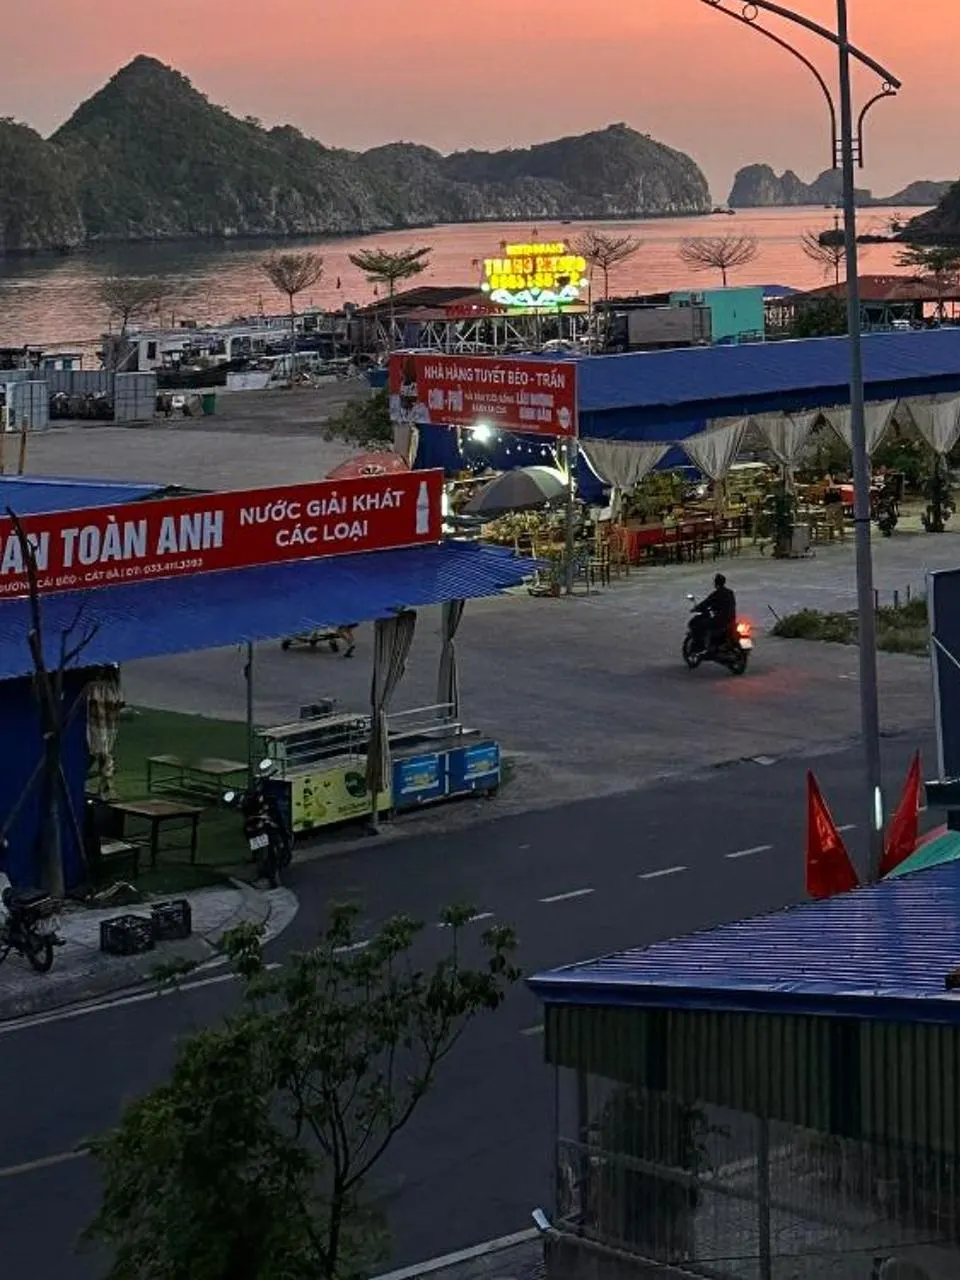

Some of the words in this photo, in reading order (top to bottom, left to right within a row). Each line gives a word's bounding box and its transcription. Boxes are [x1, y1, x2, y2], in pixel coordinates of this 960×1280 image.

[445, 362, 474, 382] HÀNG
[240, 499, 301, 526] NƯỚC
[307, 491, 346, 517] GIẢI
[353, 488, 405, 512] KHÁT
[61, 515, 147, 567] TOÀN
[156, 510, 224, 555] ANH
[276, 523, 317, 547] CÁC
[323, 520, 368, 542] LOẠI
